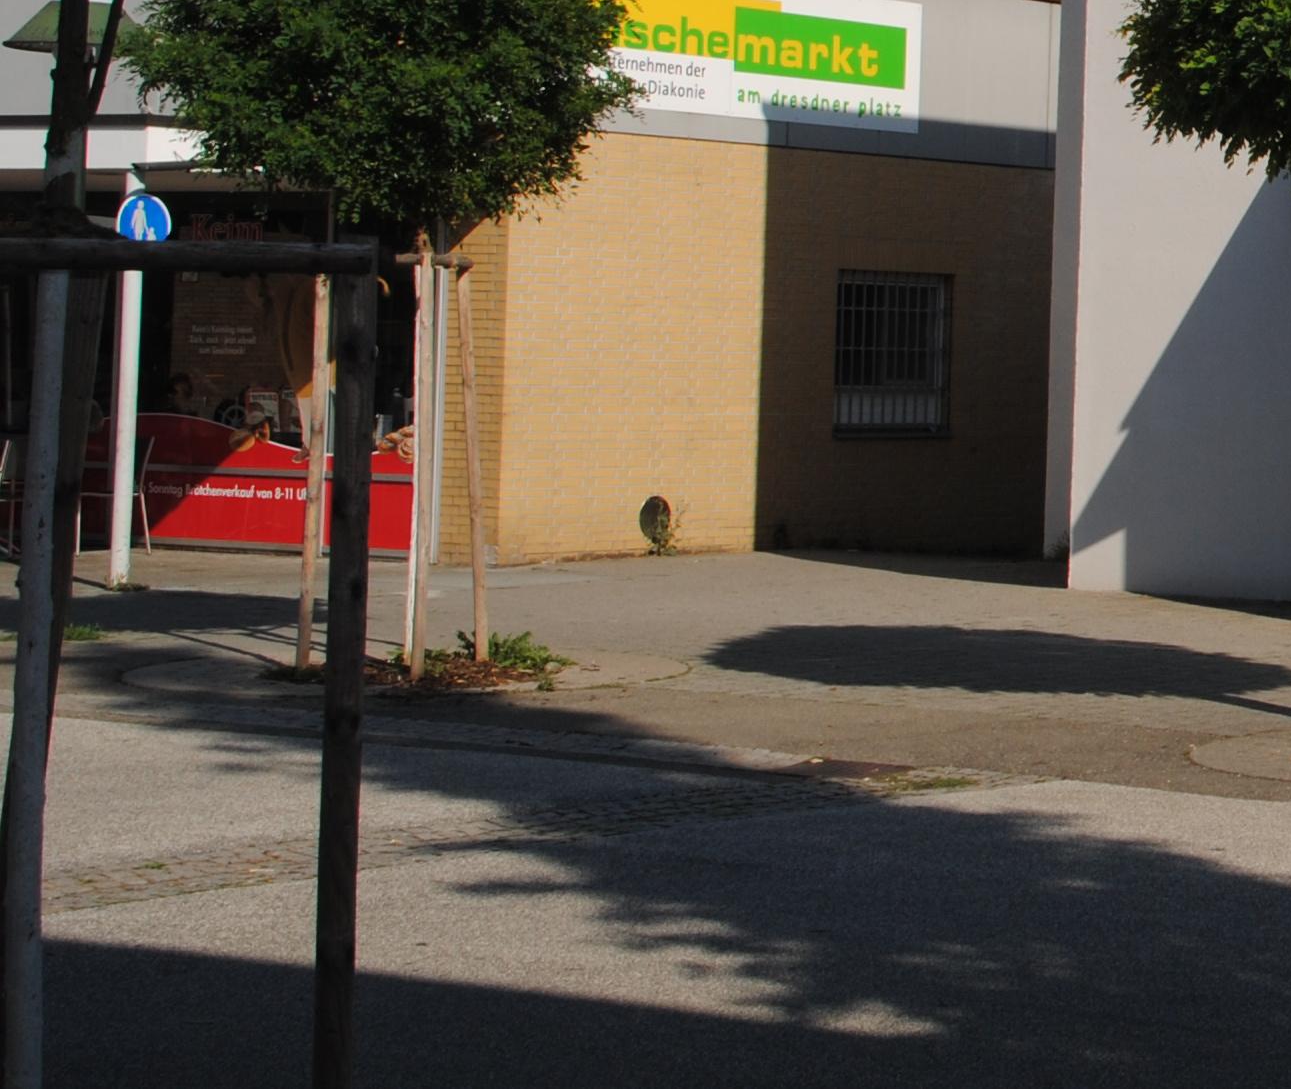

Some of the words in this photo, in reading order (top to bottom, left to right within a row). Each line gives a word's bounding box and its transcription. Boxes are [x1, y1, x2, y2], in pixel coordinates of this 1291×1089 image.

[611, 55, 682, 76] ternehmen
[685, 61, 706, 78] der
[736, 88, 761, 104] am
[771, 89, 851, 113] dresdner
[858, 97, 902, 118] platz
[191, 213, 263, 241] Keim
[148, 482, 183, 498] Sonntag
[256, 490, 273, 499] von
[274, 487, 294, 500] 8-11
